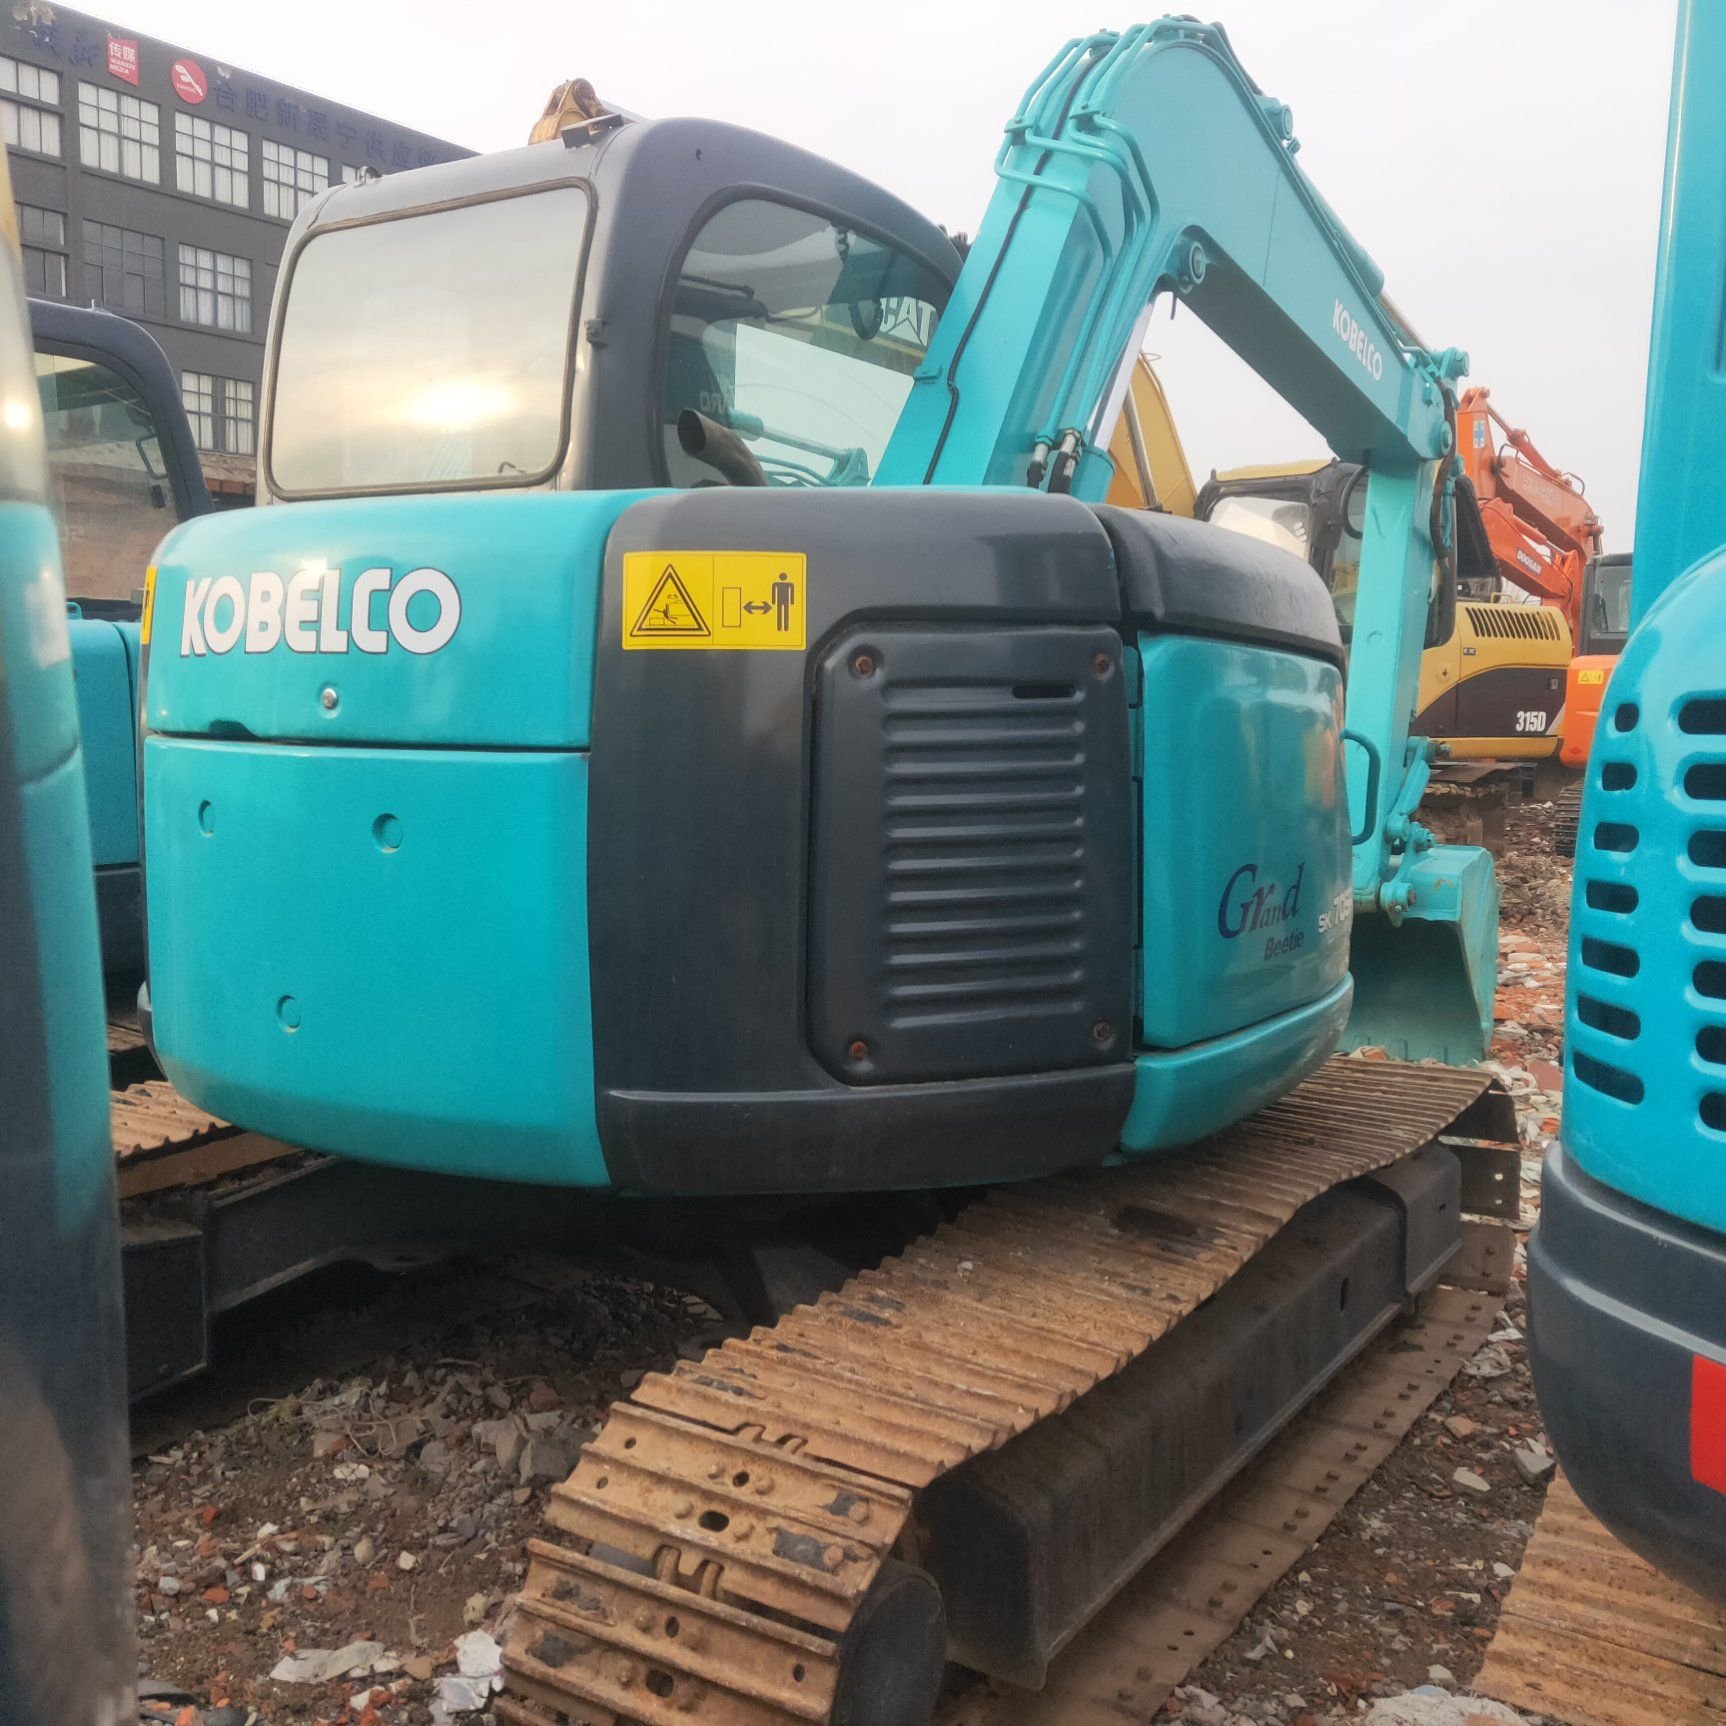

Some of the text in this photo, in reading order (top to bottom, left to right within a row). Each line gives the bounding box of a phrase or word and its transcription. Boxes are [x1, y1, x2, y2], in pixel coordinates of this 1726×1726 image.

[879, 296, 937, 347] CAT
[1331, 299, 1383, 382] KOBELCO
[1516, 549, 1542, 575] DOOSAN
[180, 566, 462, 657] KOBELCO
[1515, 710, 1547, 732] 315D
[1218, 862, 1305, 939] Grand
